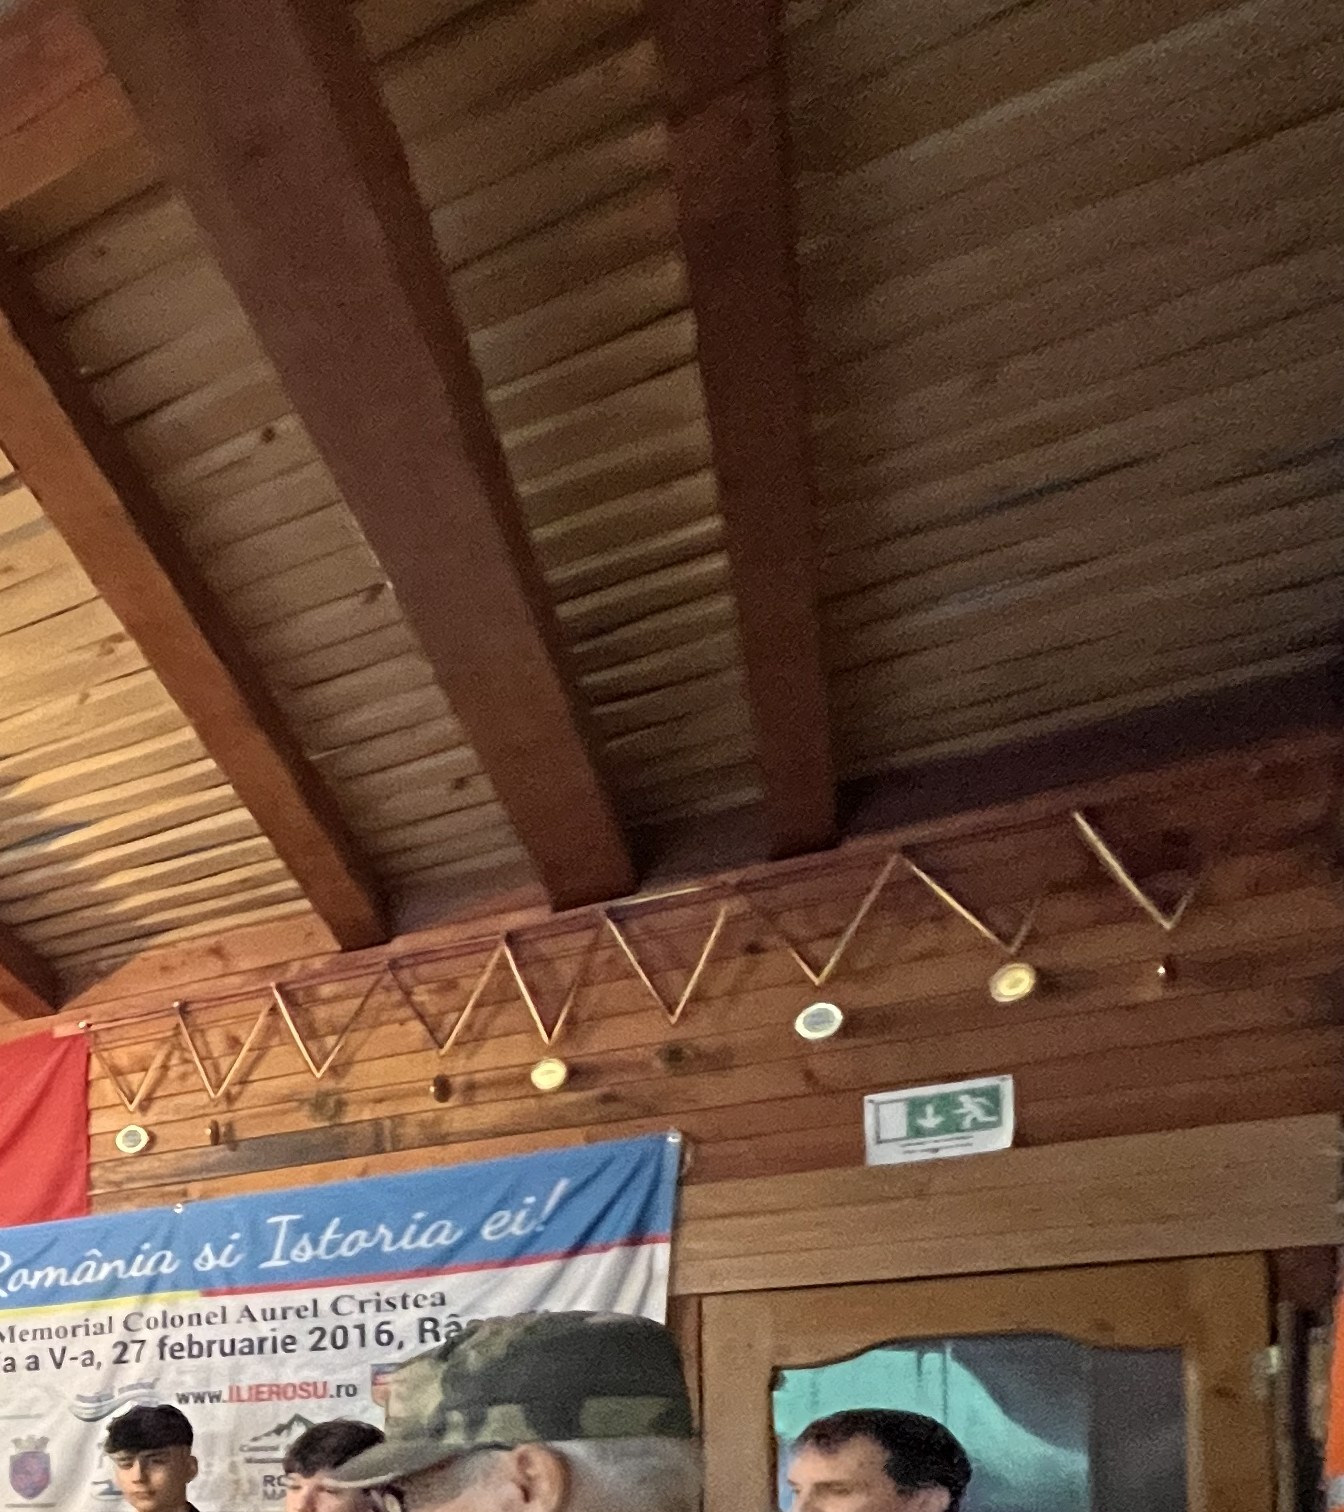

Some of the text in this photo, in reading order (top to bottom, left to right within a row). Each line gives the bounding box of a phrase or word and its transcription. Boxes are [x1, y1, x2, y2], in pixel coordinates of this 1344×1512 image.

[194, 1233, 245, 1272] si
[258, 1211, 466, 1269] Istoria
[480, 1178, 571, 1241] ei!
[122, 1305, 227, 1333] Colonel
[236, 1298, 319, 1325] Aurel
[330, 1290, 446, 1317] Cristea
[25, 1354, 41, 1372] a
[48, 1345, 102, 1371] V-a,
[111, 1339, 147, 1365] 27
[157, 1328, 297, 1361] februarie
[308, 1320, 404, 1352] 2016,
